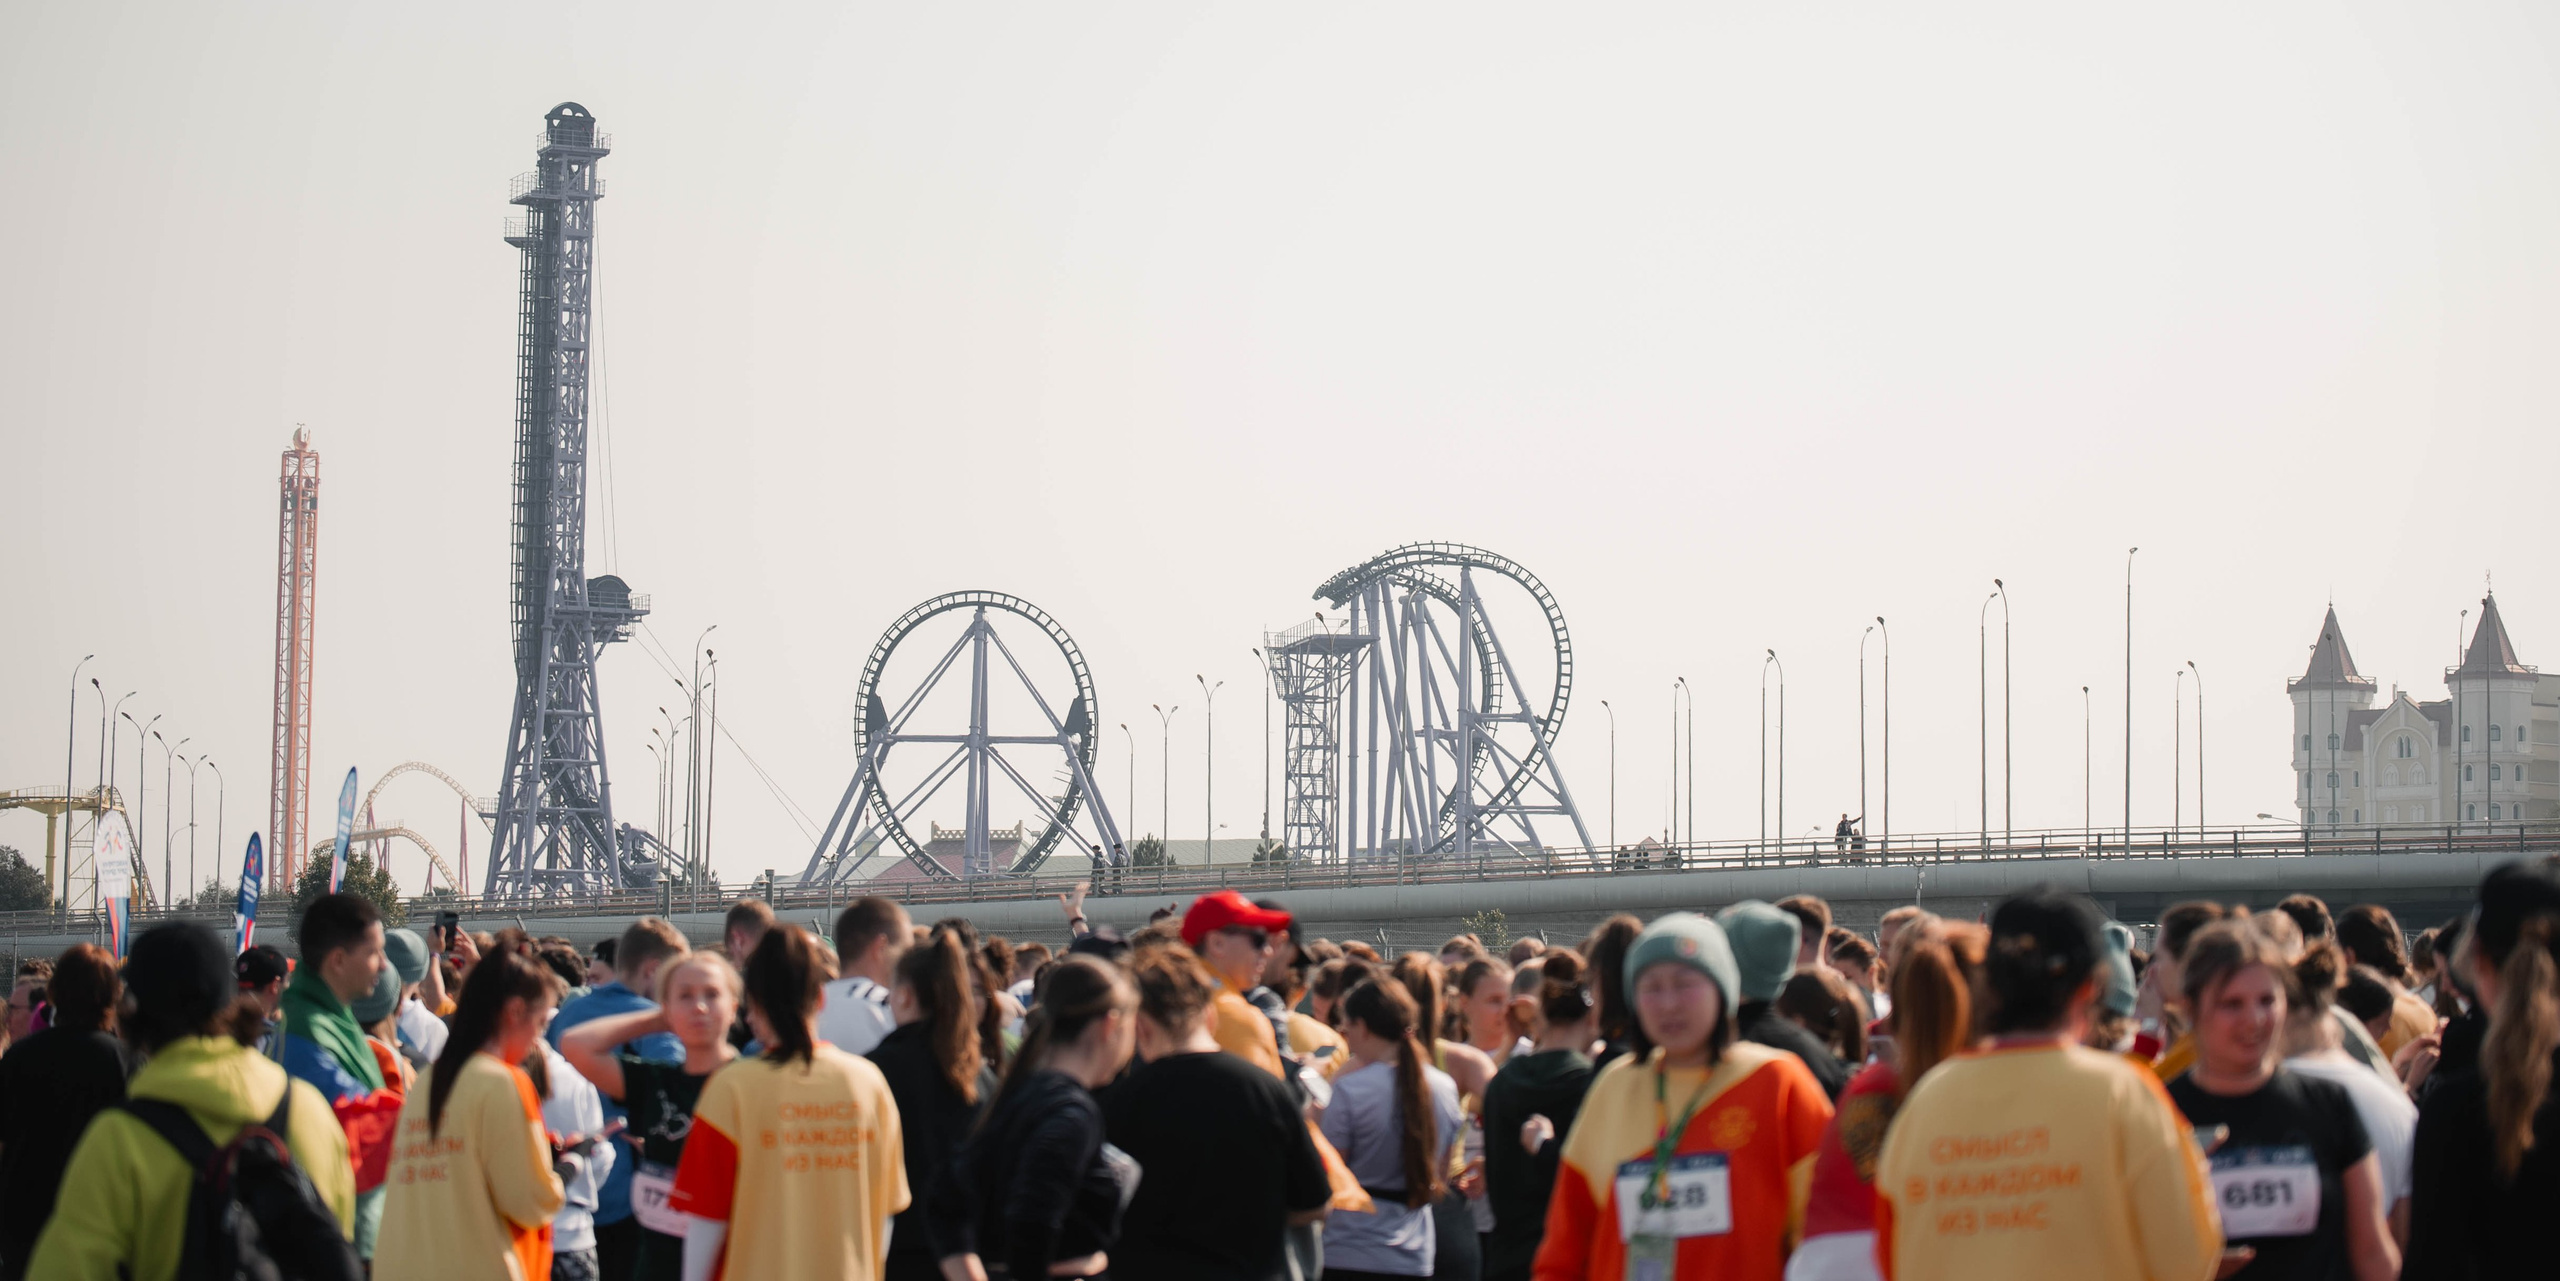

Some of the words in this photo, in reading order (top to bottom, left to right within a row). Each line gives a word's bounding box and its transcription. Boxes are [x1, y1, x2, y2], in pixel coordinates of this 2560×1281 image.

[761, 1130, 778, 1149] В
[1930, 1124, 2049, 1166] СМЫСЛ
[784, 1154, 809, 1172] ИЗ
[815, 1151, 859, 1170] НАС
[1905, 1174, 1928, 1204] В
[1934, 1162, 2083, 1197] КАЖДОМ
[2223, 1178, 2293, 1210] 681
[1937, 1207, 1979, 1236] ИЗ
[1983, 1201, 2048, 1232] НАС
